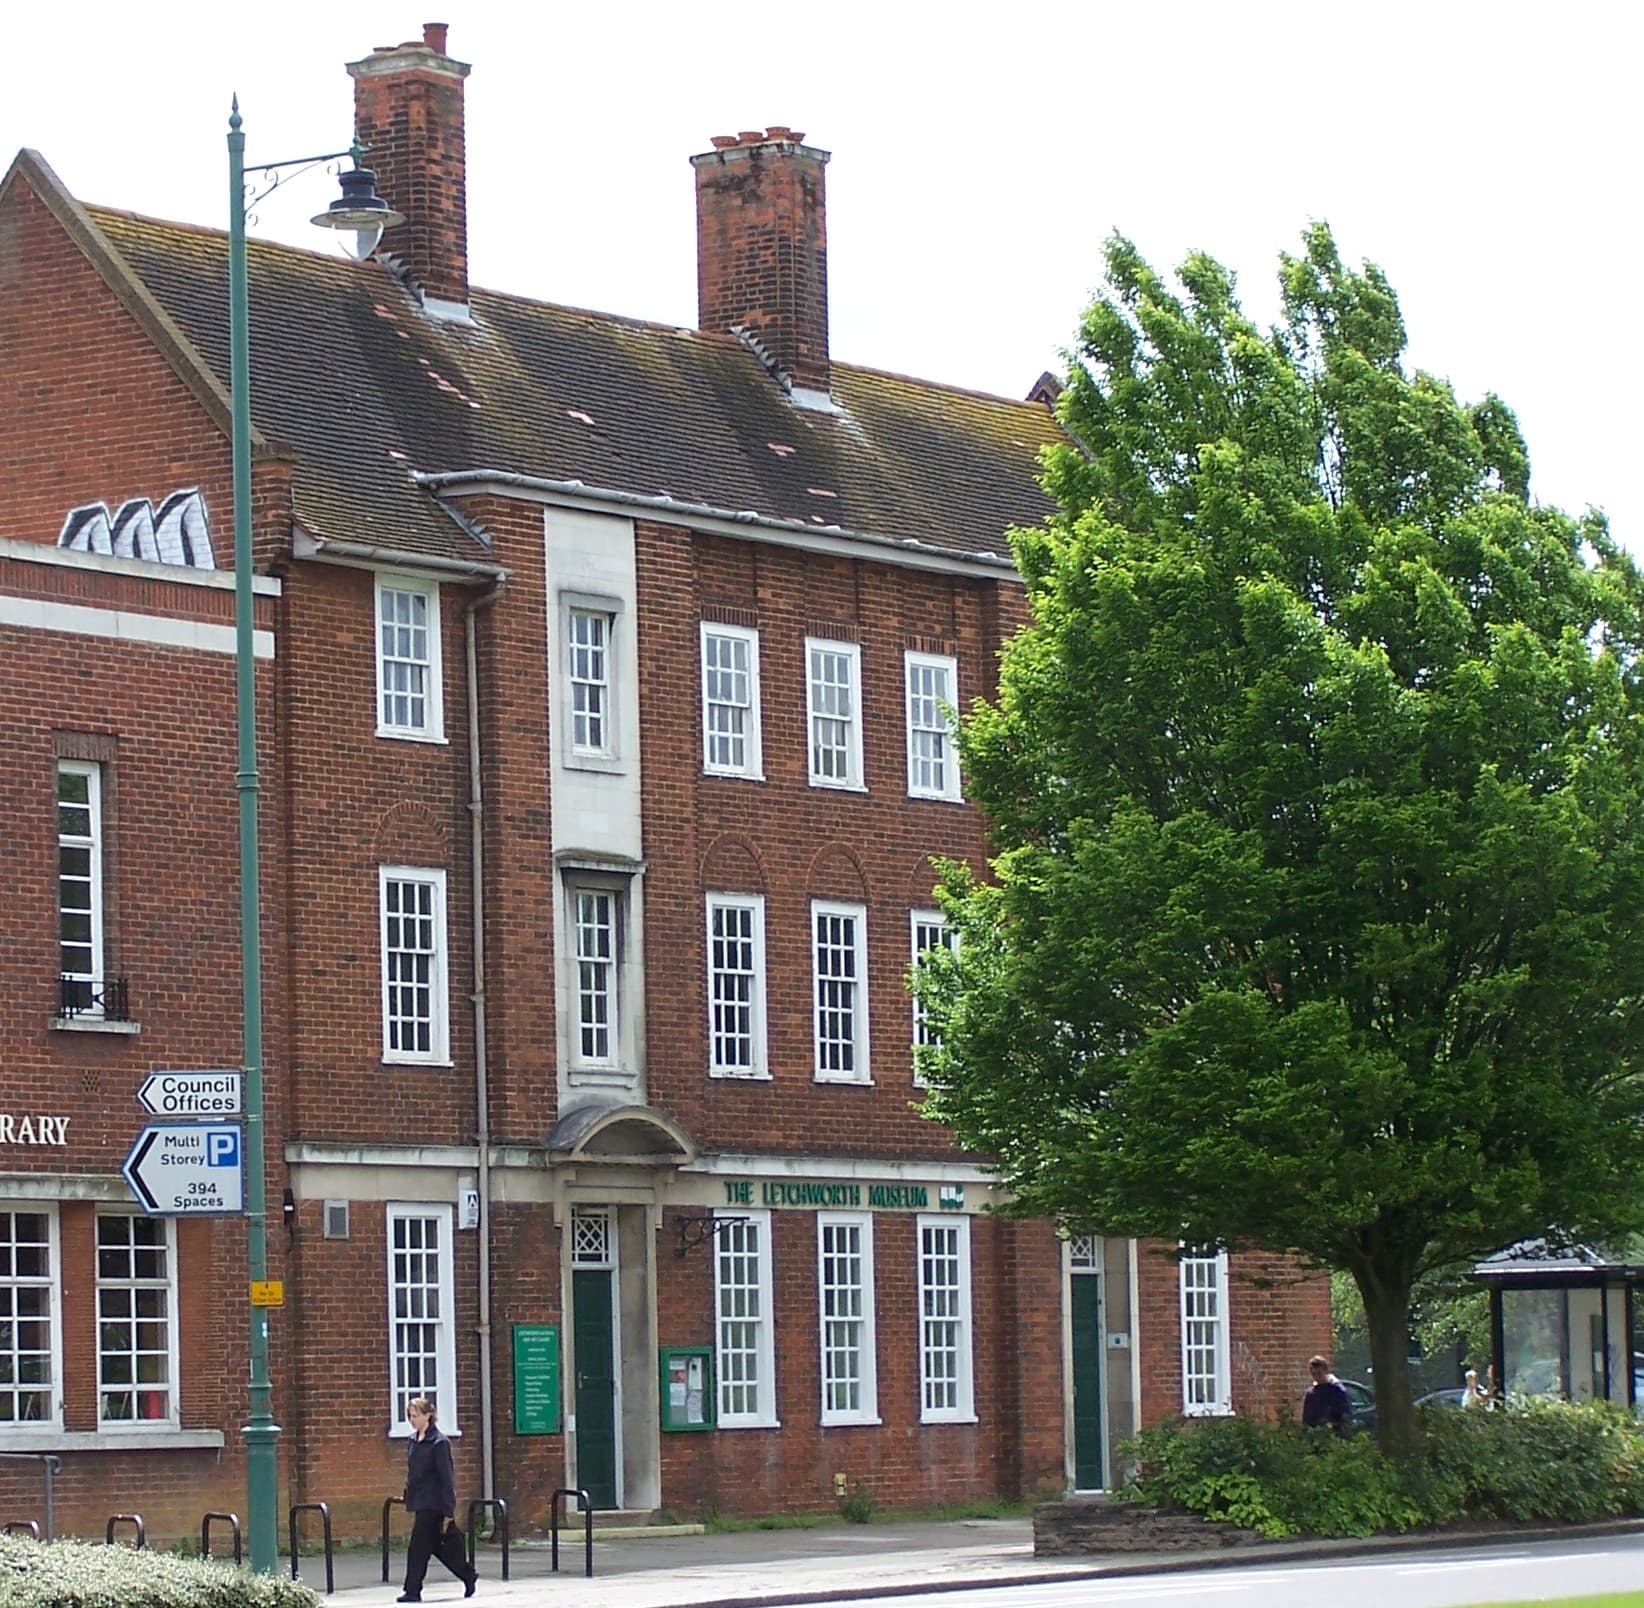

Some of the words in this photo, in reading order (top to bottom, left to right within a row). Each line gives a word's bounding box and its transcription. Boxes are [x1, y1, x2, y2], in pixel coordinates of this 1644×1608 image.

[162, 1076, 235, 1093] Council
[162, 1095, 235, 1111] Offices
[0, 1114, 71, 1145] RARY
[165, 1136, 200, 1147] Multi
[210, 1134, 235, 1165] P
[161, 1154, 205, 1166] Storey
[187, 1182, 217, 1194] 394
[723, 1181, 753, 1205] THE
[762, 1182, 860, 1207] LETCHWORTH
[868, 1185, 928, 1208] MUSEUM
[173, 1196, 224, 1209] Spaces
